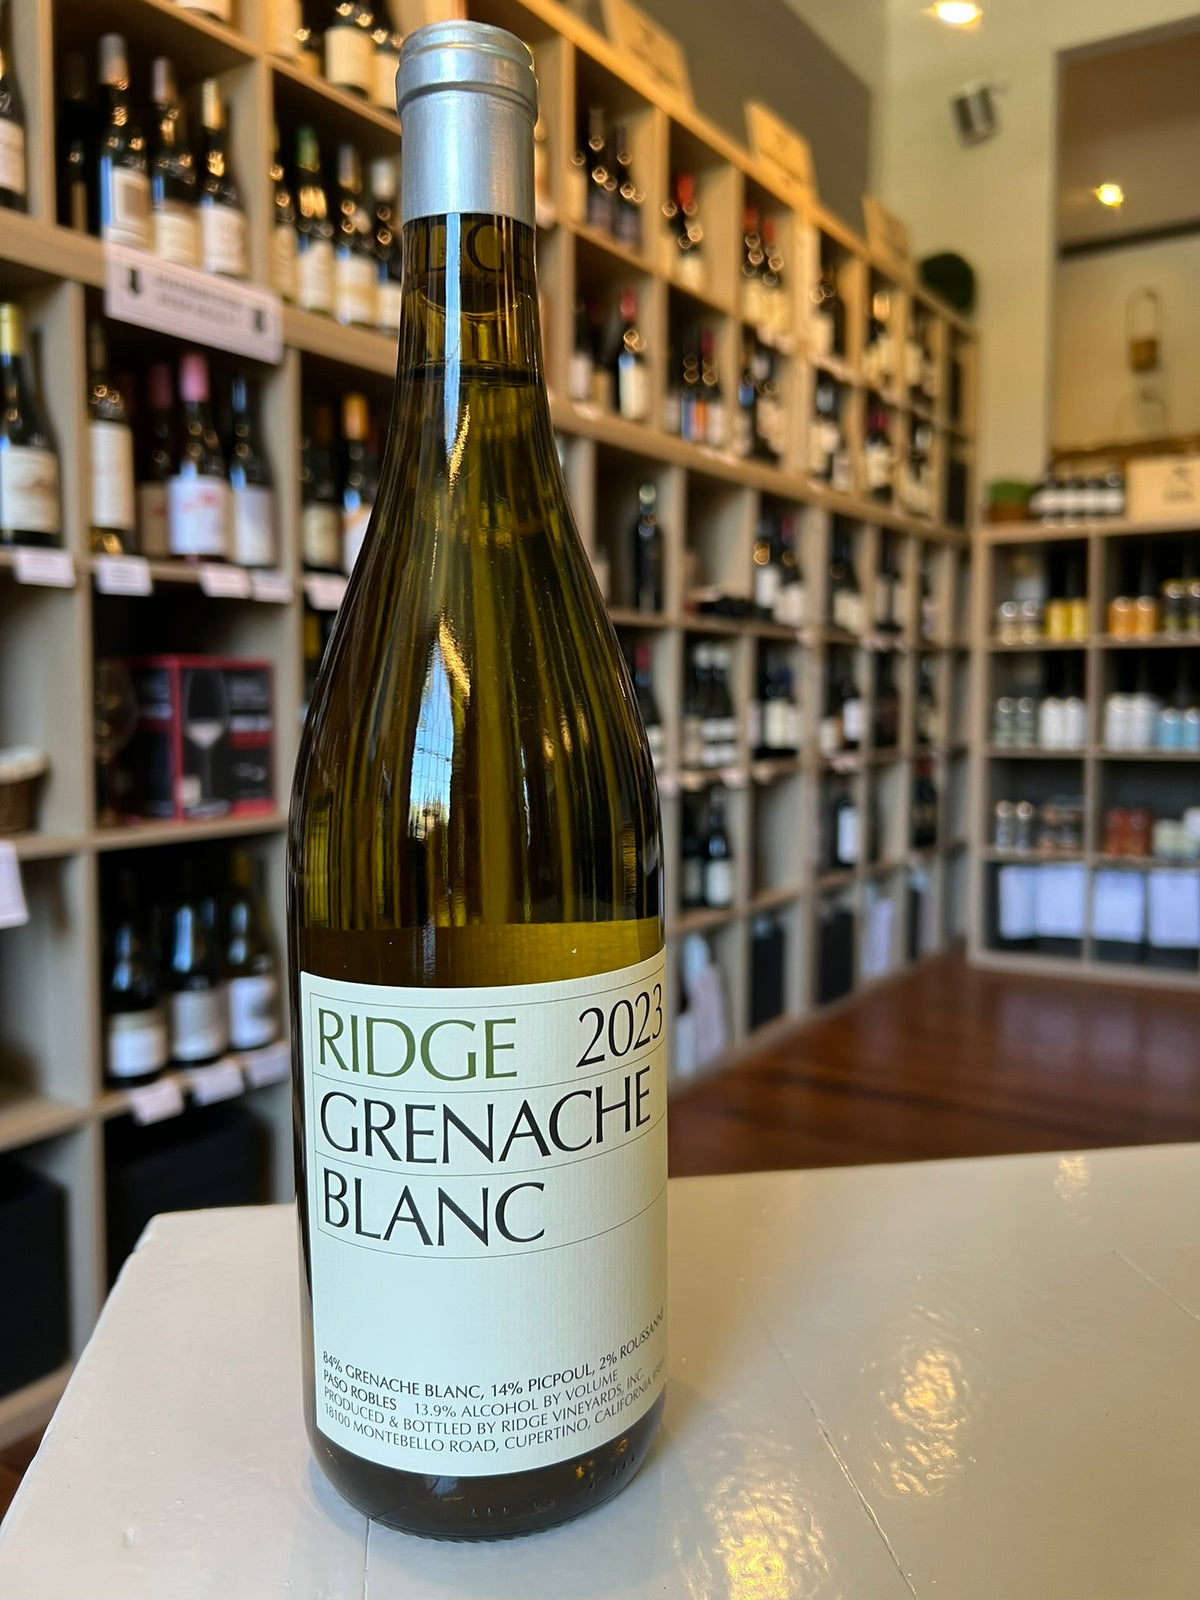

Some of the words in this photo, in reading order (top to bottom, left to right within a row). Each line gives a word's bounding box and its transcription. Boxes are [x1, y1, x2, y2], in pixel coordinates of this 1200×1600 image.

[318, 1007, 517, 1081] RIDGE
[576, 983, 663, 1068] 2023
[320, 1065, 651, 1164] GRENACHE
[323, 1167, 545, 1246] BLANC
[323, 1351, 343, 1373] 84%
[345, 1364, 420, 1396] GRENACHE
[425, 1384, 484, 1401] BLANC,
[491, 1381, 523, 1397] 14%
[528, 1363, 596, 1392] PICPOUL,
[599, 1351, 618, 1370] 2%
[323, 1369, 348, 1393] PASO
[350, 1385, 397, 1411] ROBLES
[414, 1402, 457, 1418] 13.9%
[461, 1398, 538, 1418] ALCOHOL
[543, 1392, 562, 1408] BY
[565, 1369, 619, 1401] VOLUME
[324, 1386, 385, 1424] PRODUCED
[389, 1415, 399, 1429] &
[403, 1418, 472, 1435] BOTTLED
[477, 1421, 497, 1435] BY
[501, 1413, 548, 1432] RIDGE
[552, 1383, 625, 1422] VINEYARDS,
[325, 1403, 351, 1428] 18100
[353, 1420, 445, 1452] MONTEBELLO
[449, 1439, 499, 1453] ROAD,
[504, 1418, 591, 1450] CUPERTINO,
[594, 1376, 652, 1424] CALIFORNIA
